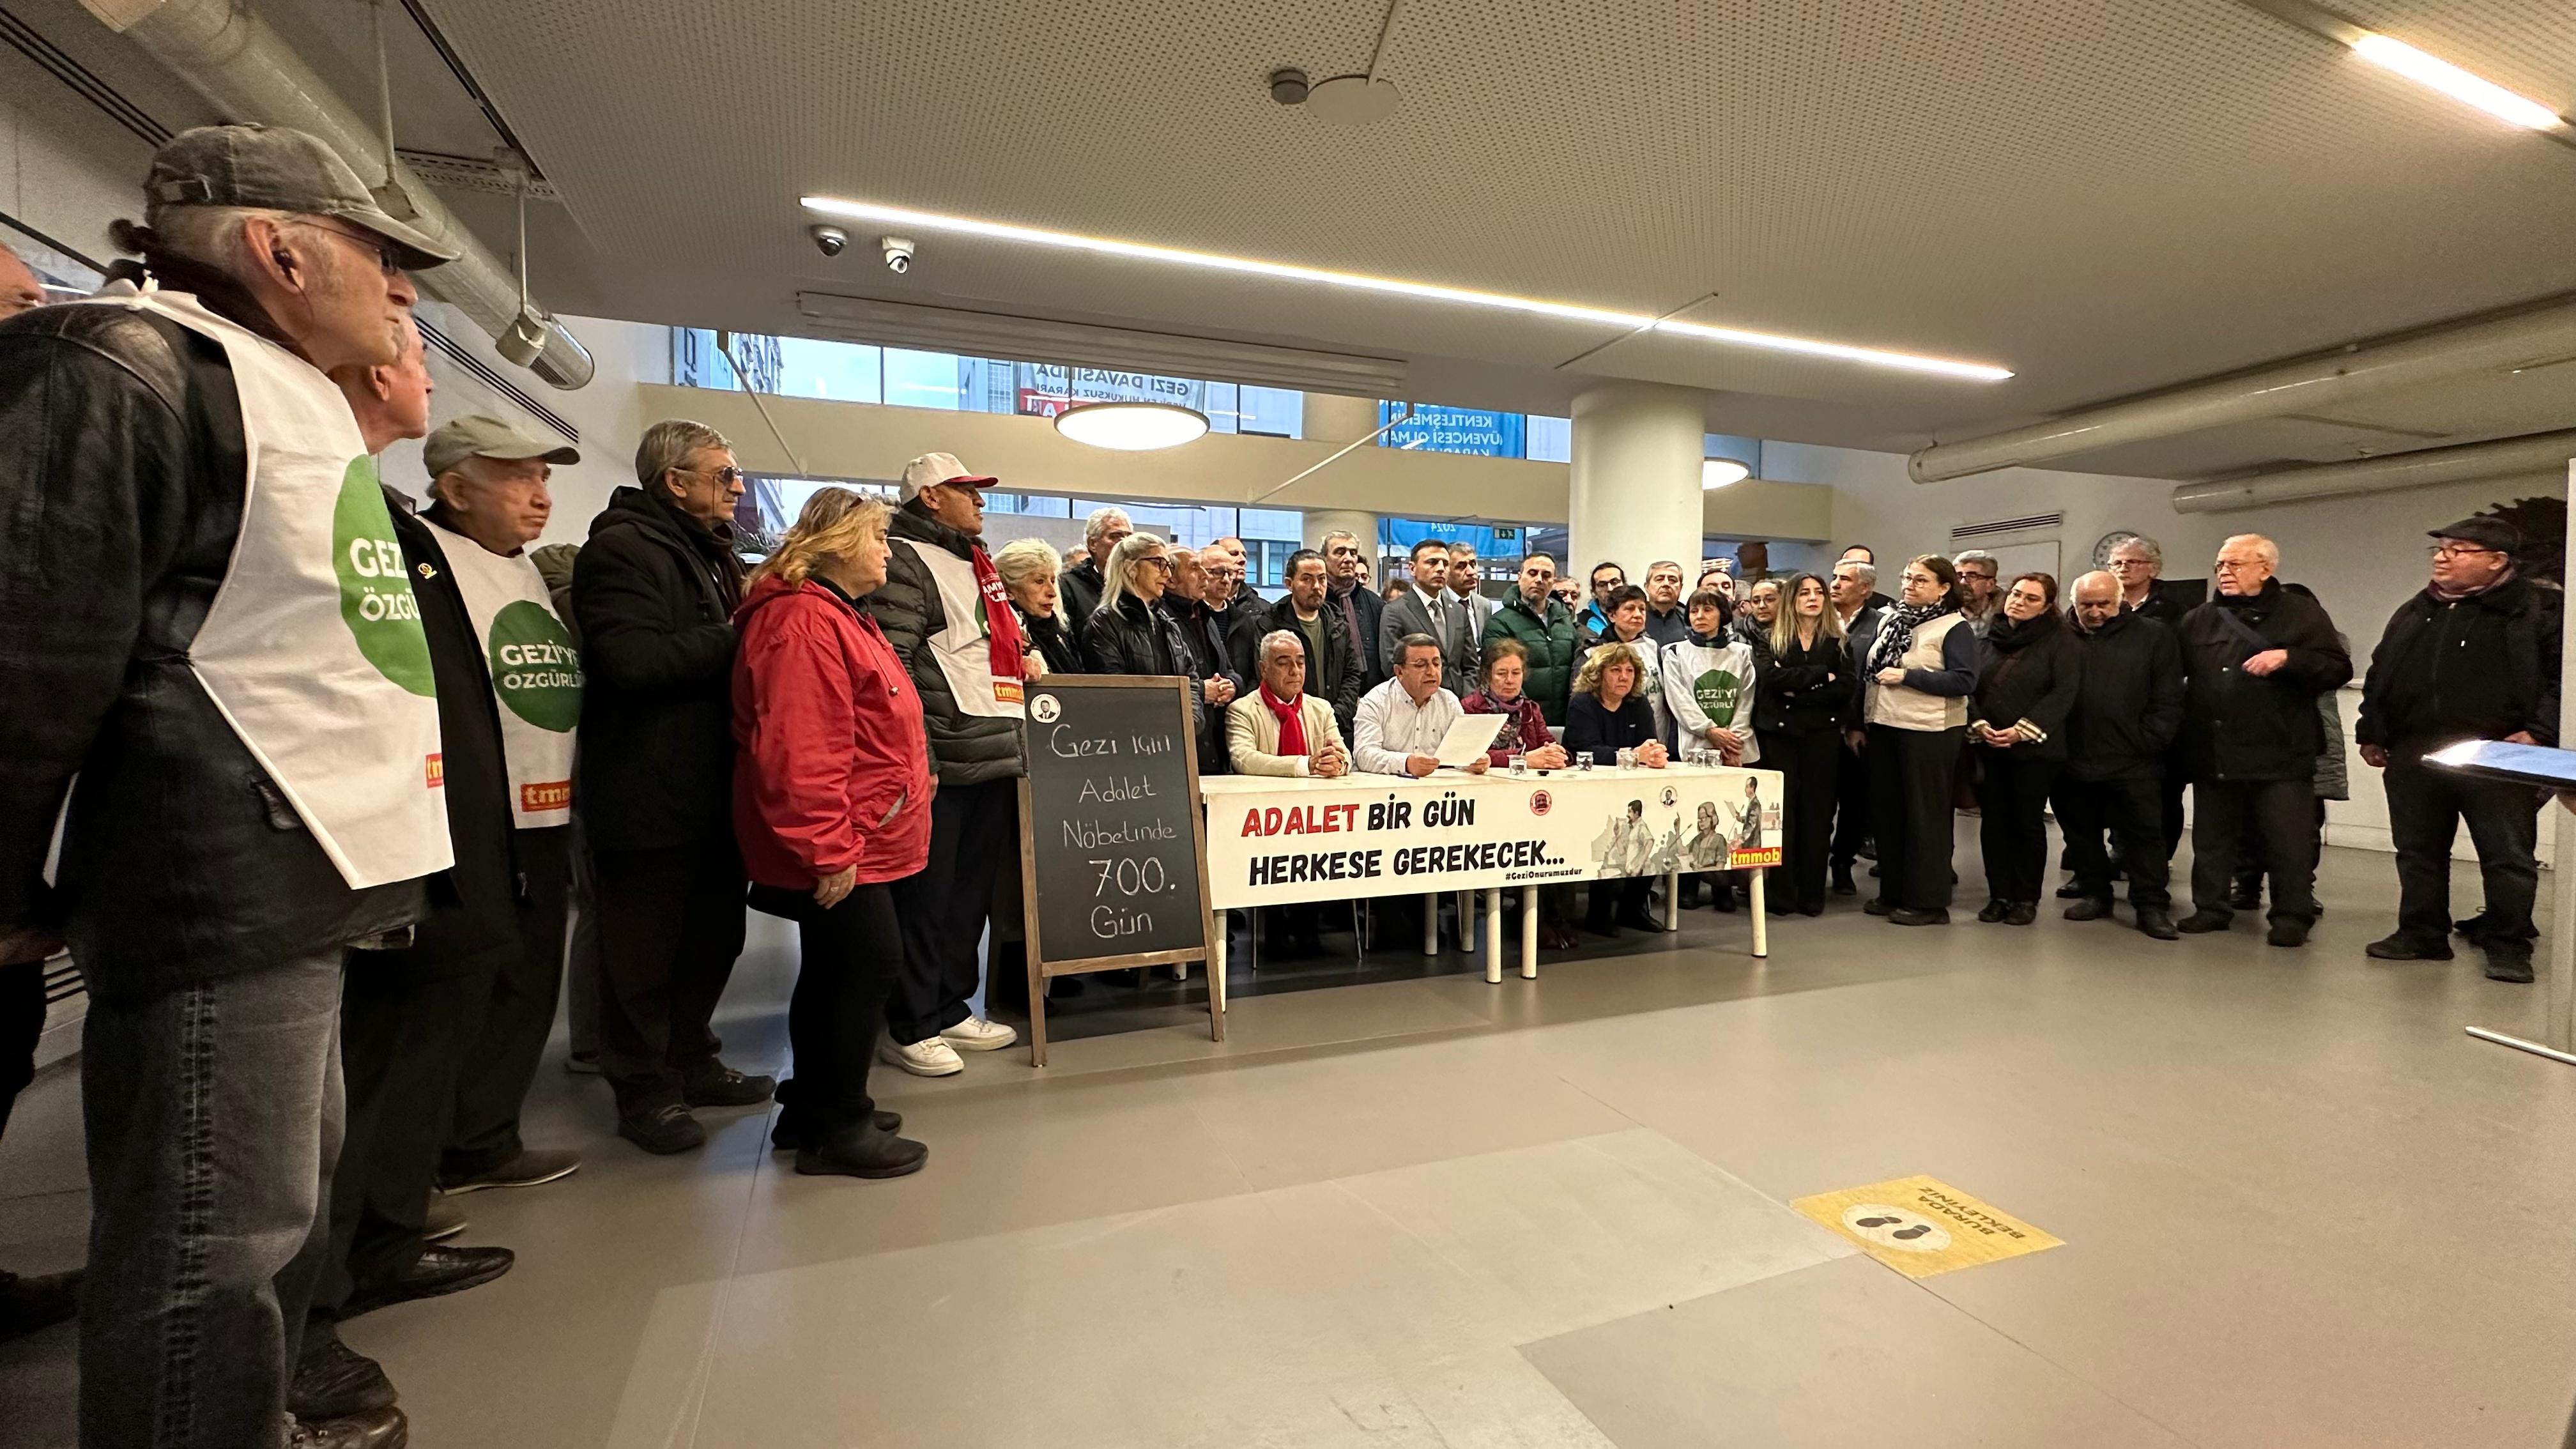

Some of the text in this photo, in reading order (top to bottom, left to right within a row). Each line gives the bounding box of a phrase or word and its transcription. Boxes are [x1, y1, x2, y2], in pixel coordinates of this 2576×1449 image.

[1051, 724, 1117, 758] Gezi
[1078, 775, 1157, 804] Adalet
[1241, 791, 1475, 838] ADALET BİR GÜN
[1249, 839, 1565, 886] HERKESE GEREKECEK...
[1732, 848, 1781, 865] tmmob
[1089, 857, 1176, 898] 700.
[1505, 868, 1583, 880] #GeziOnurumuzdur
[1091, 905, 1153, 939] Gün
[1918, 1195, 1995, 1235] BURADA
